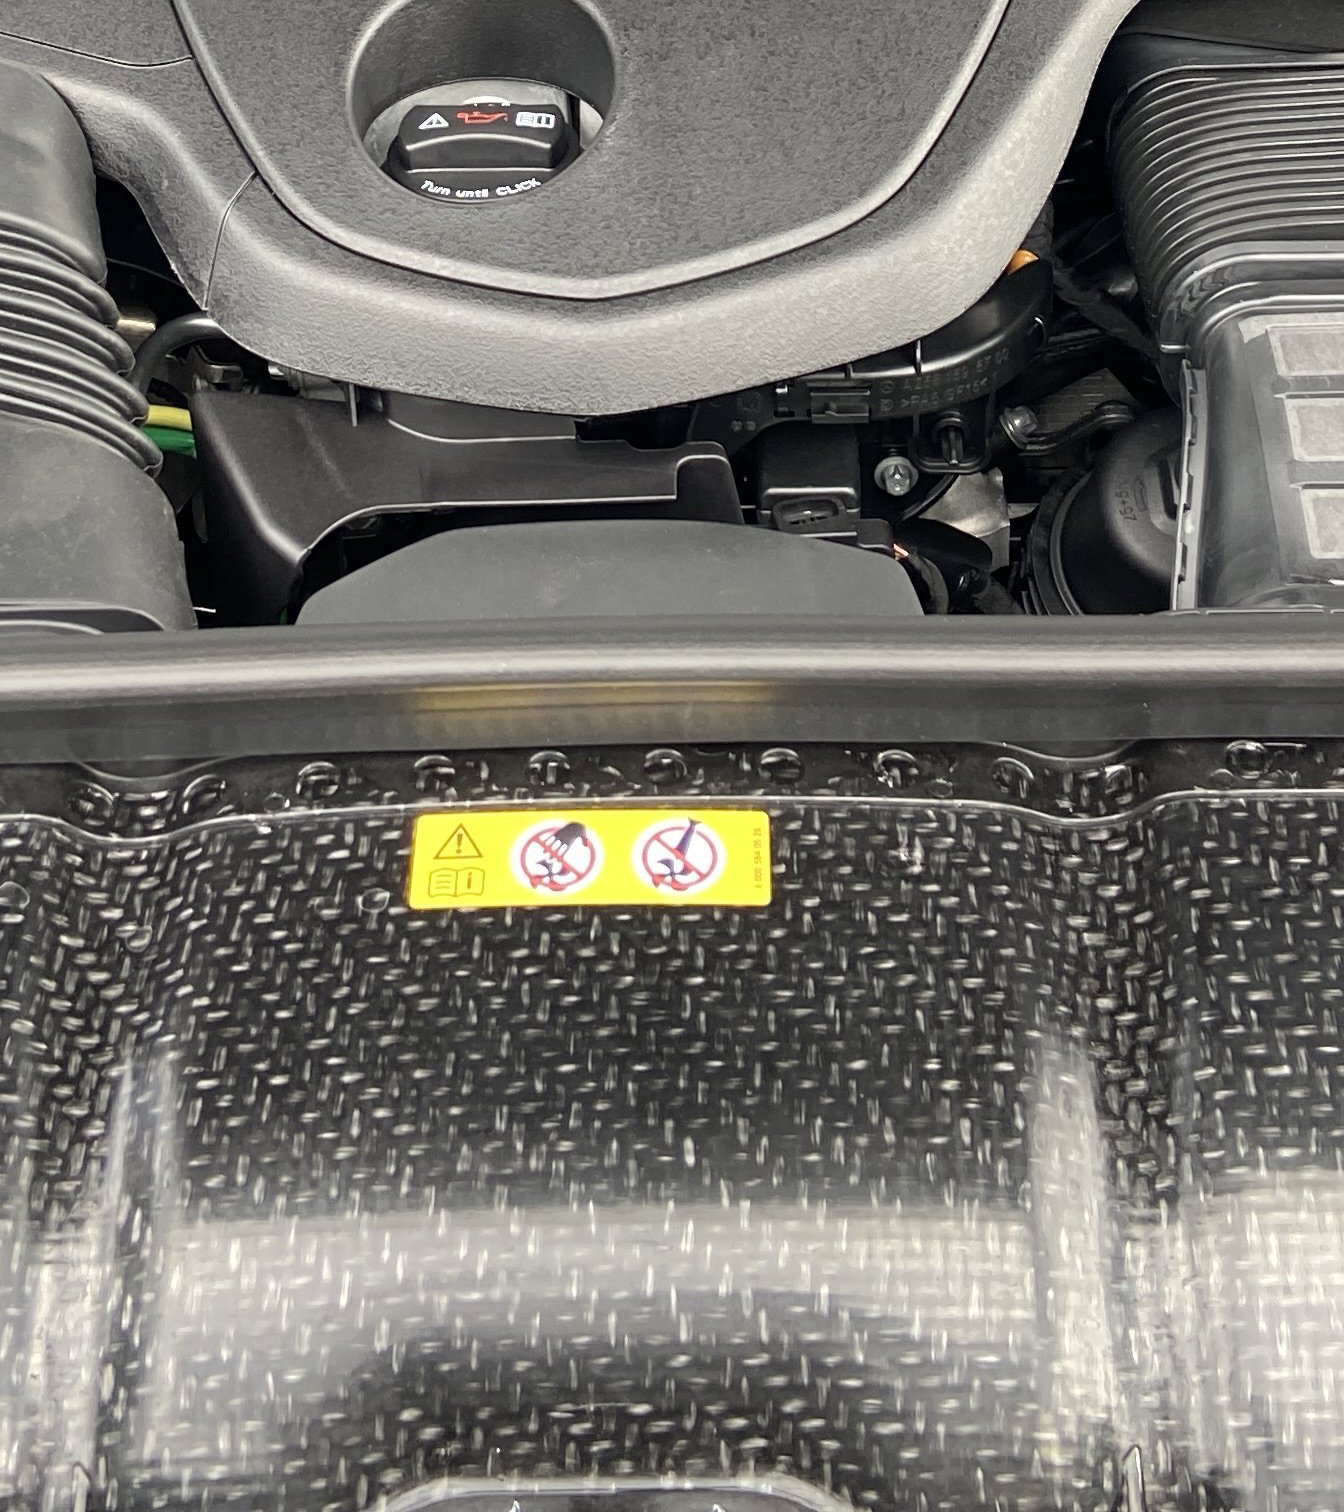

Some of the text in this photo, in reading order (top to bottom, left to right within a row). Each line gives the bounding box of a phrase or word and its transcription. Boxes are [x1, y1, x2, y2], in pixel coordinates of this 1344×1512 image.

[420, 177, 542, 199] Turn until CLICK
